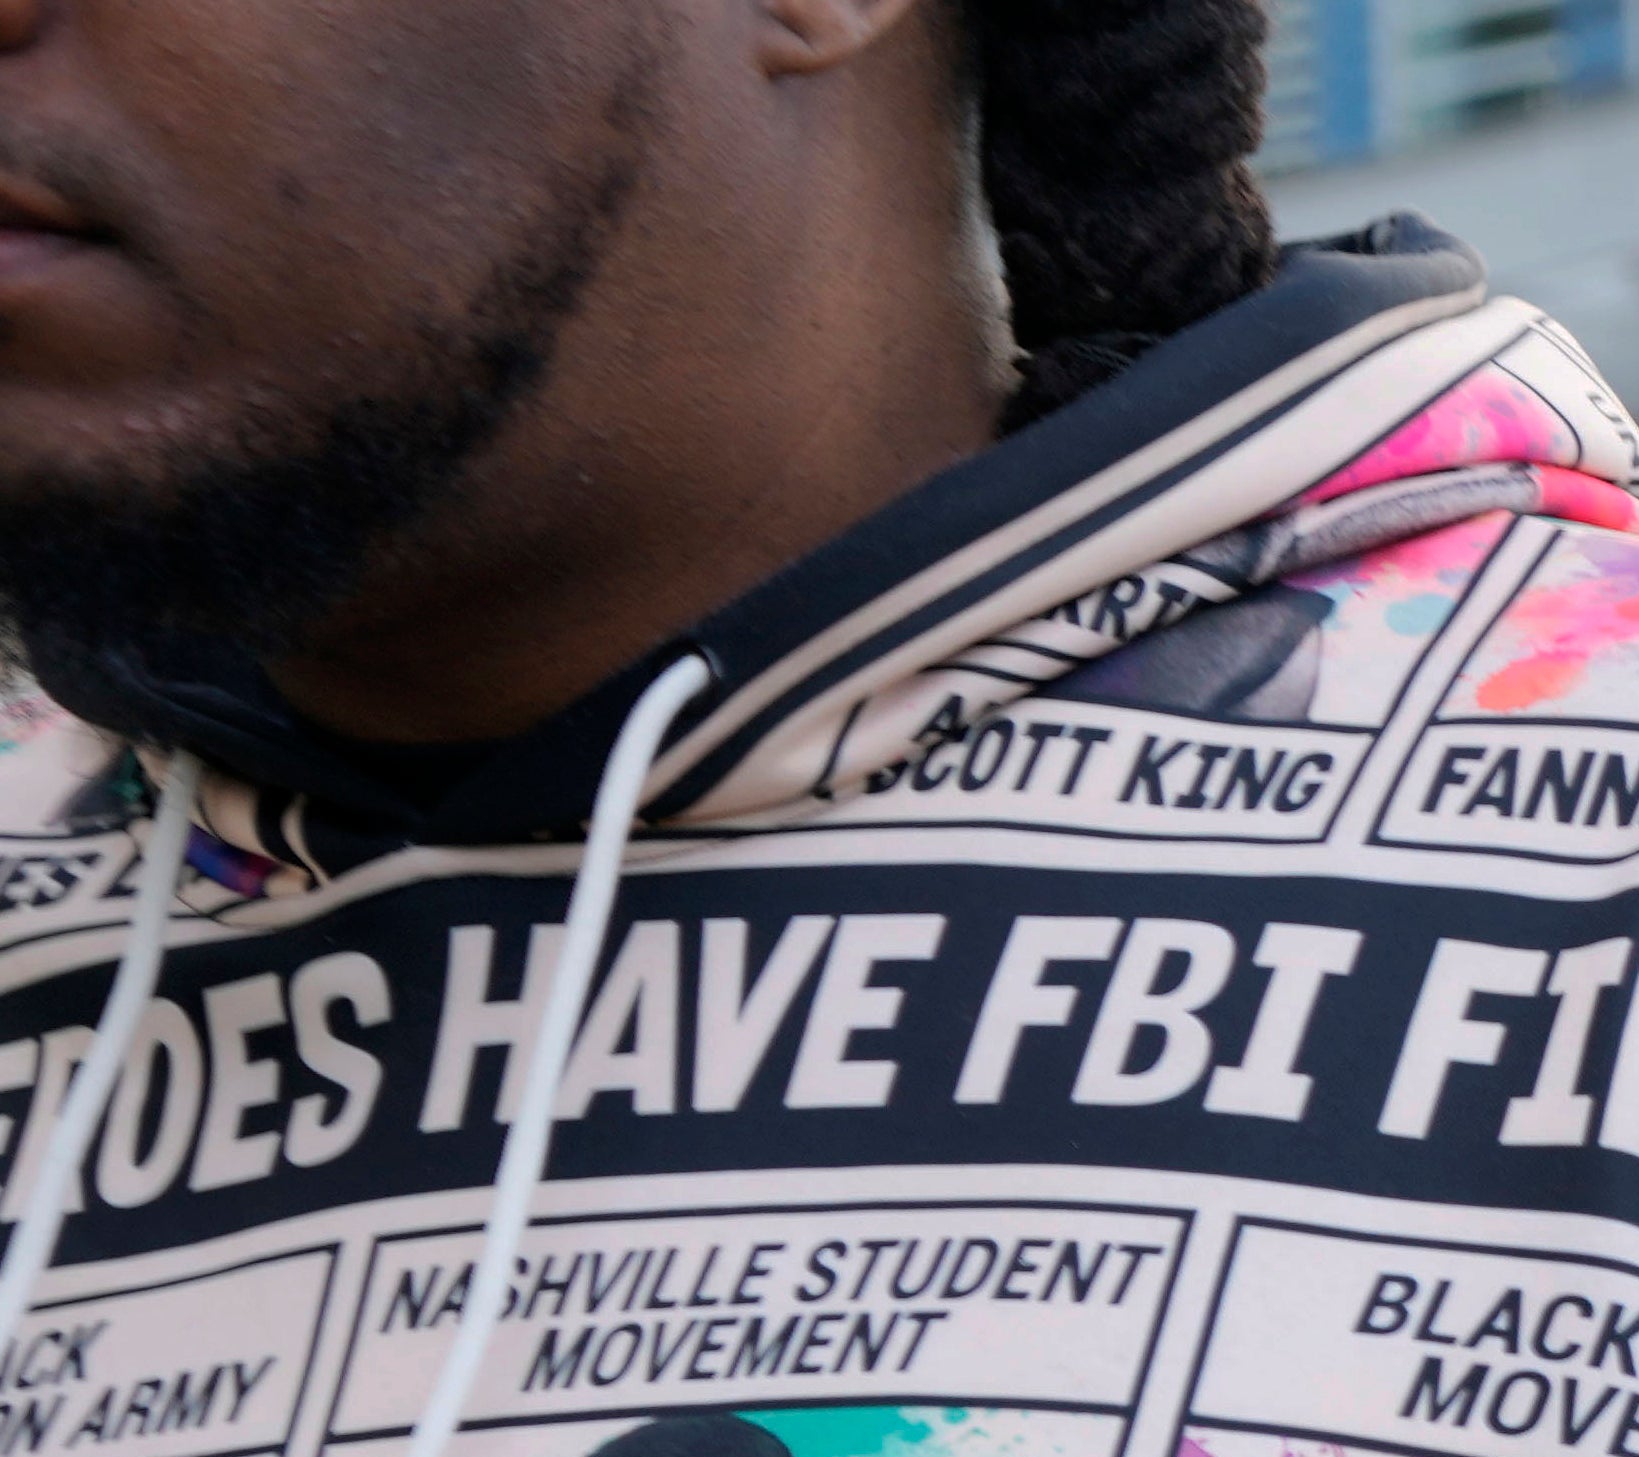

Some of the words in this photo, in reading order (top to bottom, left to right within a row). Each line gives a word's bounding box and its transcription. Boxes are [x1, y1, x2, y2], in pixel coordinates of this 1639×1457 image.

[1118, 733, 1334, 814] KING
[418, 912, 947, 1134] HAVE
[953, 912, 1364, 1122] FBI
[378, 1244, 786, 1336] NASHVILLE
[794, 1238, 1160, 1312] STUDENT
[520, 1308, 950, 1394] MOVEMENT
[63, 1354, 280, 1452] ARMY
